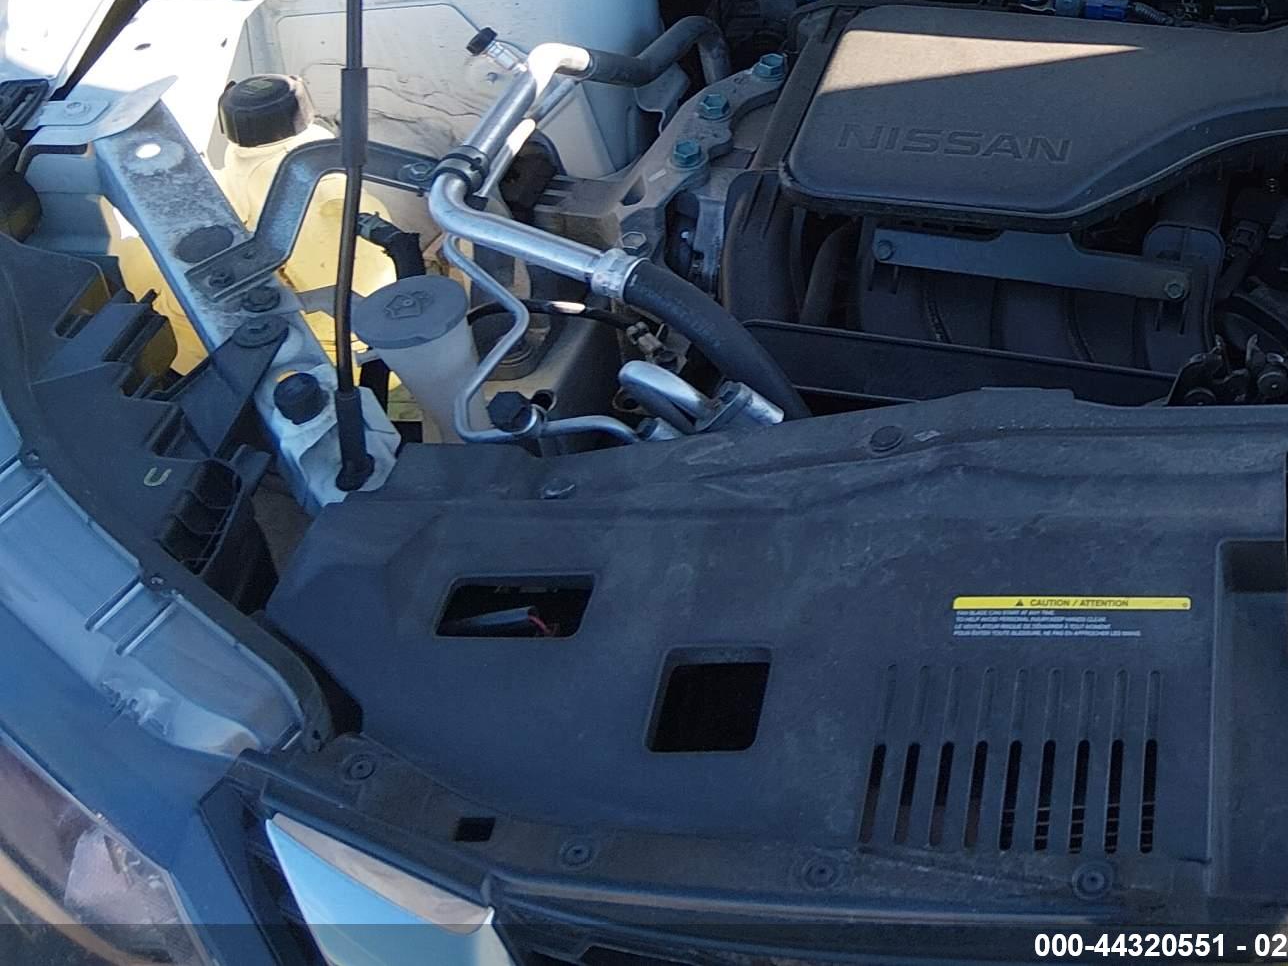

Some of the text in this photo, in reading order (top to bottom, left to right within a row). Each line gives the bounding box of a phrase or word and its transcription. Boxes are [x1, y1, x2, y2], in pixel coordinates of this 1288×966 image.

[837, 122, 1071, 164] NISSAN
[1030, 599, 1070, 607] CAUTION
[1080, 599, 1129, 607] ATTENTION
